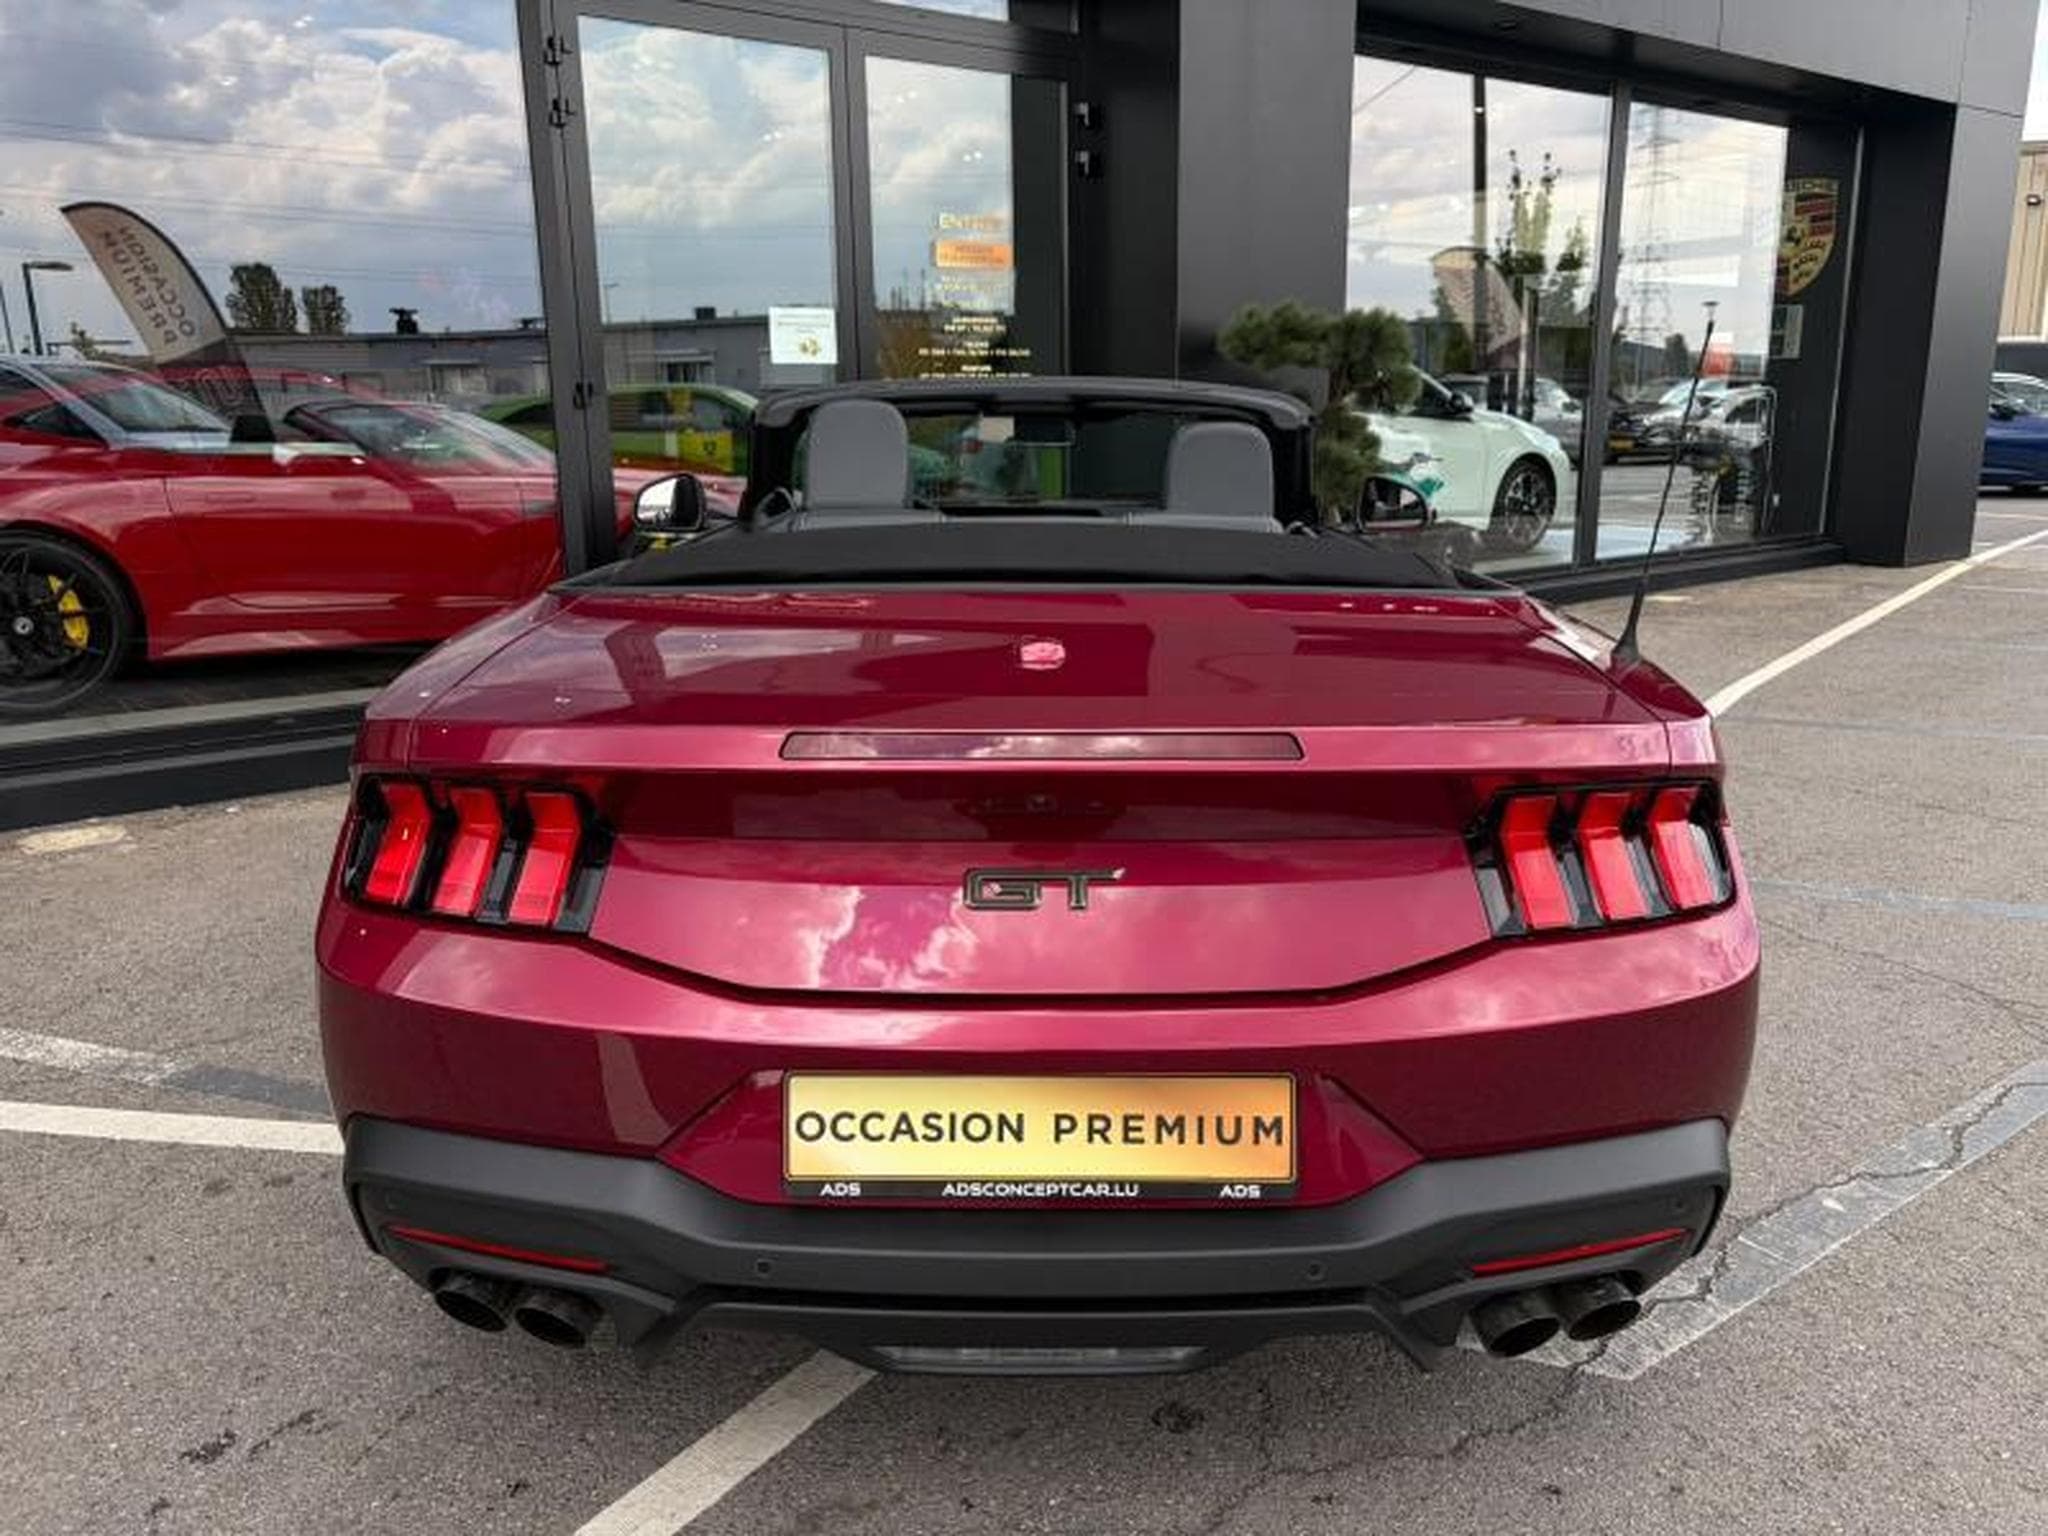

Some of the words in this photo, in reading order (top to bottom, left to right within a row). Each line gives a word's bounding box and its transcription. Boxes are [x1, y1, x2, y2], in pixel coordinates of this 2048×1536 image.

[962, 867, 1126, 911] GT
[795, 1112, 1025, 1143] OCCASION
[1054, 1113, 1284, 1146] PREMIUM
[820, 1182, 862, 1197] ADS
[941, 1182, 1140, 1198] ADSCONCEPTCAR.LU
[1219, 1183, 1261, 1198] ADS
